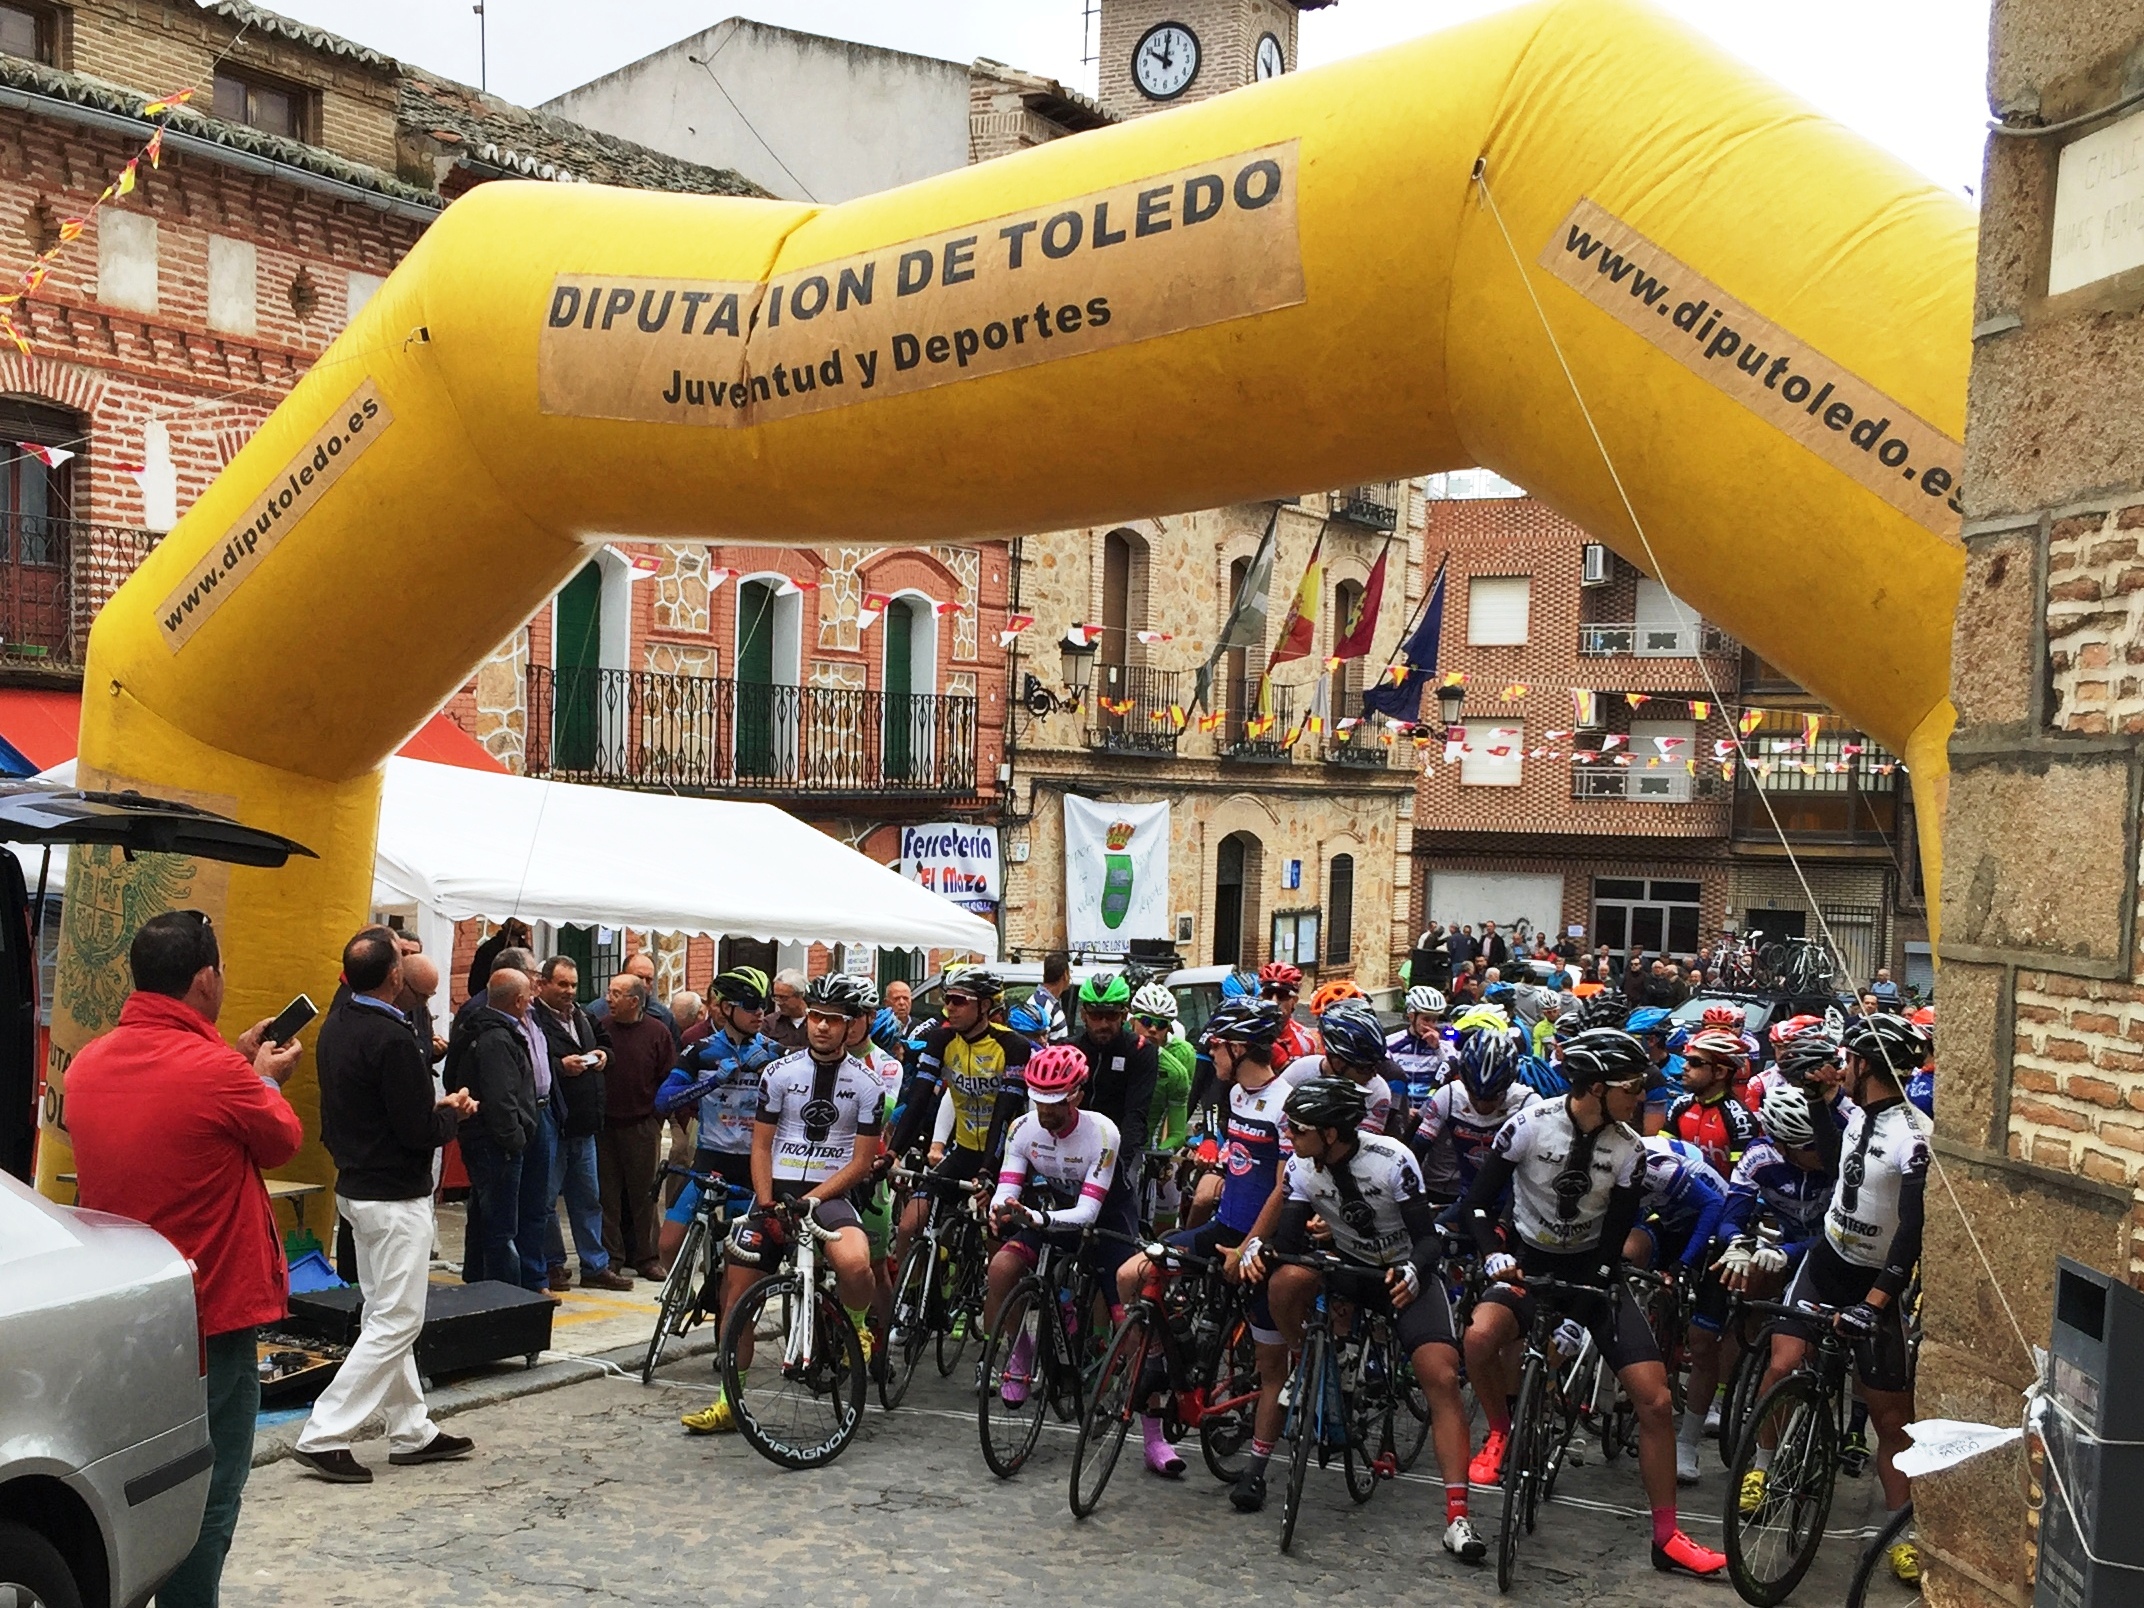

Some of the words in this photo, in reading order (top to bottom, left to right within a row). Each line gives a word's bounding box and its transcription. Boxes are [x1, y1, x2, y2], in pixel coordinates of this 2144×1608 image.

[549, 262, 875, 337] DIPUTAION
[897, 236, 977, 298] DE
[1000, 159, 1282, 269] TOLEDO
[663, 348, 844, 411] Juventud
[854, 350, 878, 389] y
[893, 296, 1112, 372] Deportes
[1565, 222, 1964, 514] www.diputoledo.es
[162, 395, 381, 634] www.diputoledo.es
[942, 866, 987, 894] Mazo
[738, 1398, 857, 1461] CAMPAGNOLO
